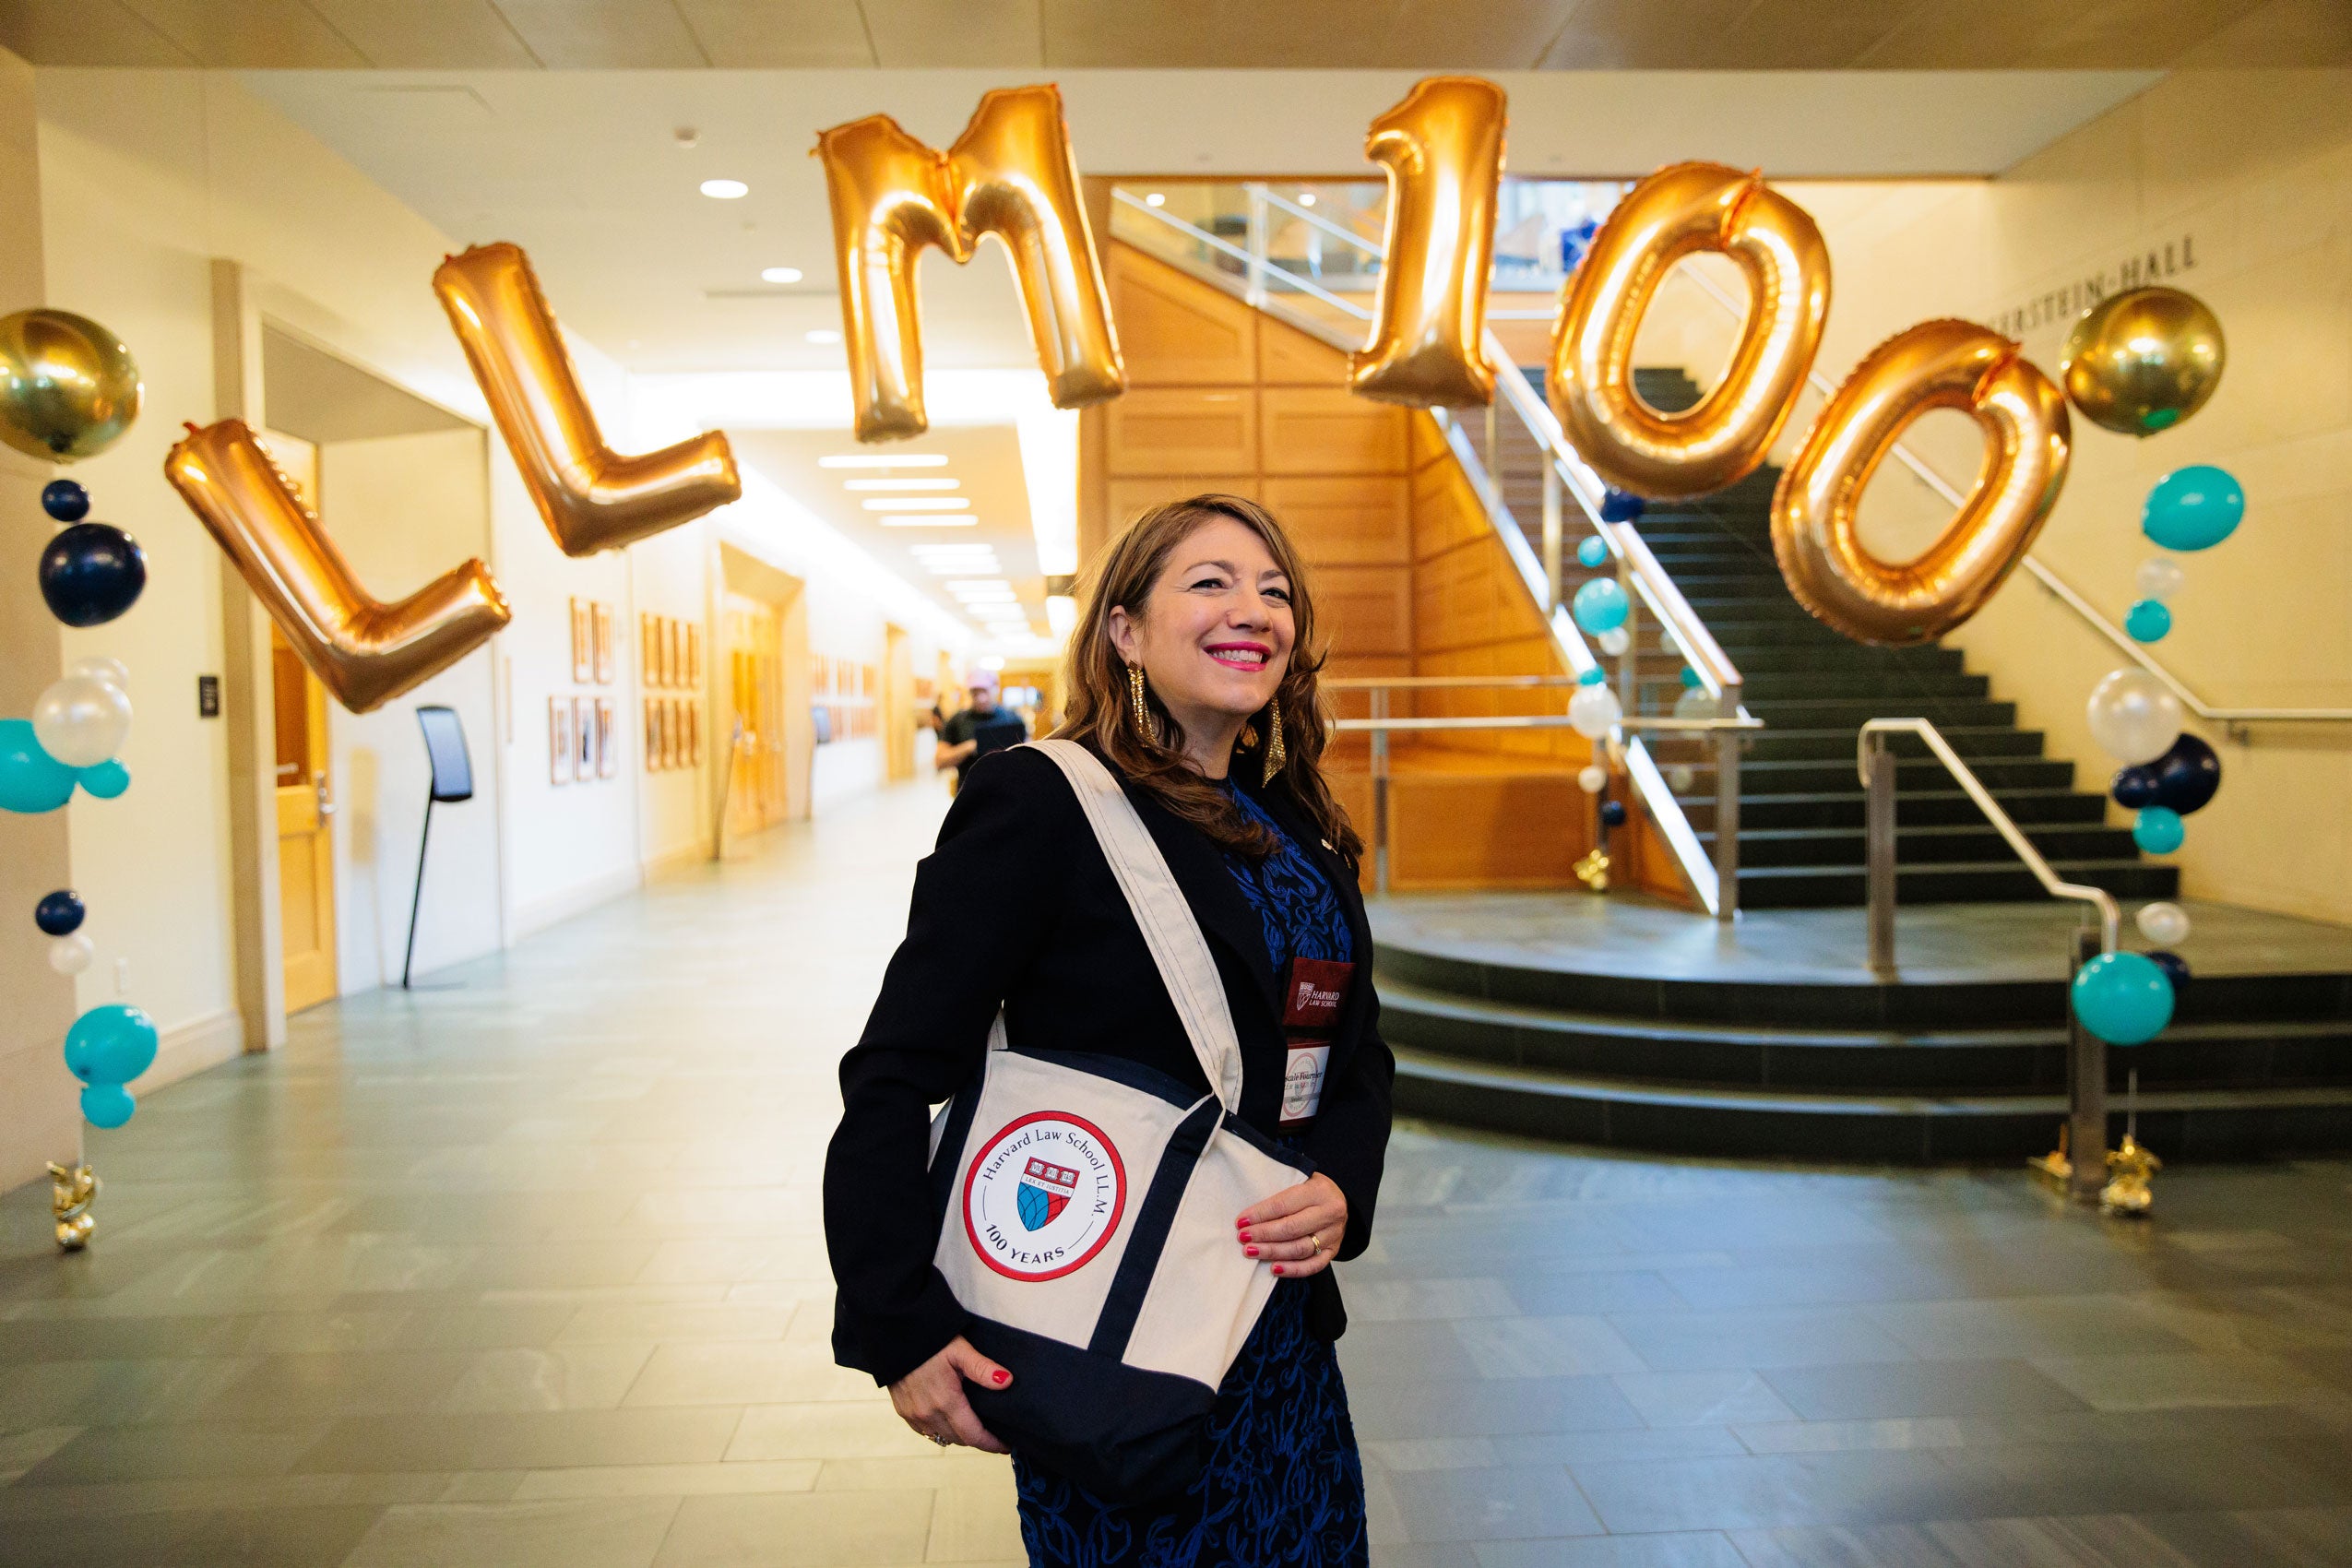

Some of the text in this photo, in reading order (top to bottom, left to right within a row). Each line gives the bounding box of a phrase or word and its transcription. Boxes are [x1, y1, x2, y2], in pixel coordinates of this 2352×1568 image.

[2120, 234, 2196, 287] HALL
[1311, 991, 1340, 1001] HARVARD
[983, 1129, 1110, 1217] Harvard Law School LL.M.
[986, 1224, 1064, 1264] 100 YEARS
